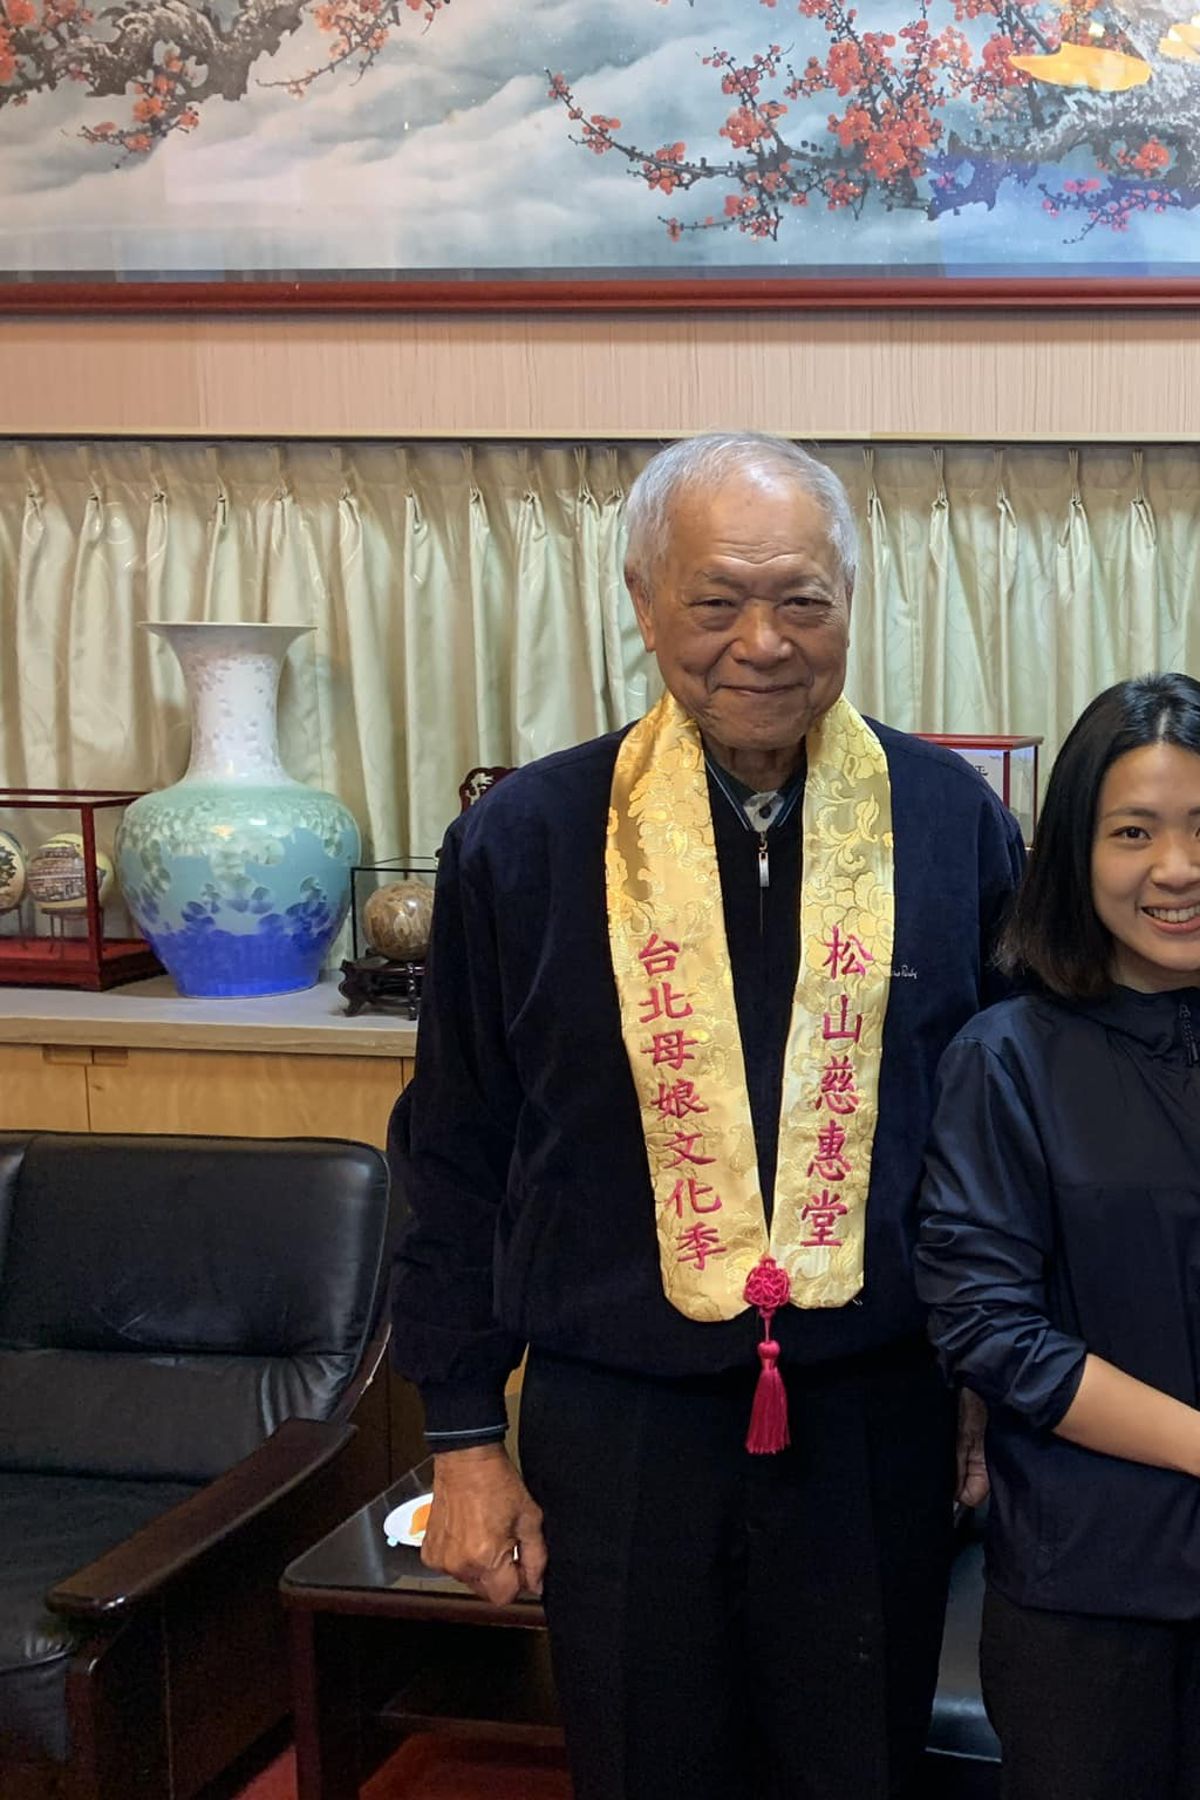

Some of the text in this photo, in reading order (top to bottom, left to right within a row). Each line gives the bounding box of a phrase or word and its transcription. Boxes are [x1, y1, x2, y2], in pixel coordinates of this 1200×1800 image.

[638, 933, 727, 1271] 台北母娘文化季
[801, 925, 873, 1247] 松山慈惠堂
